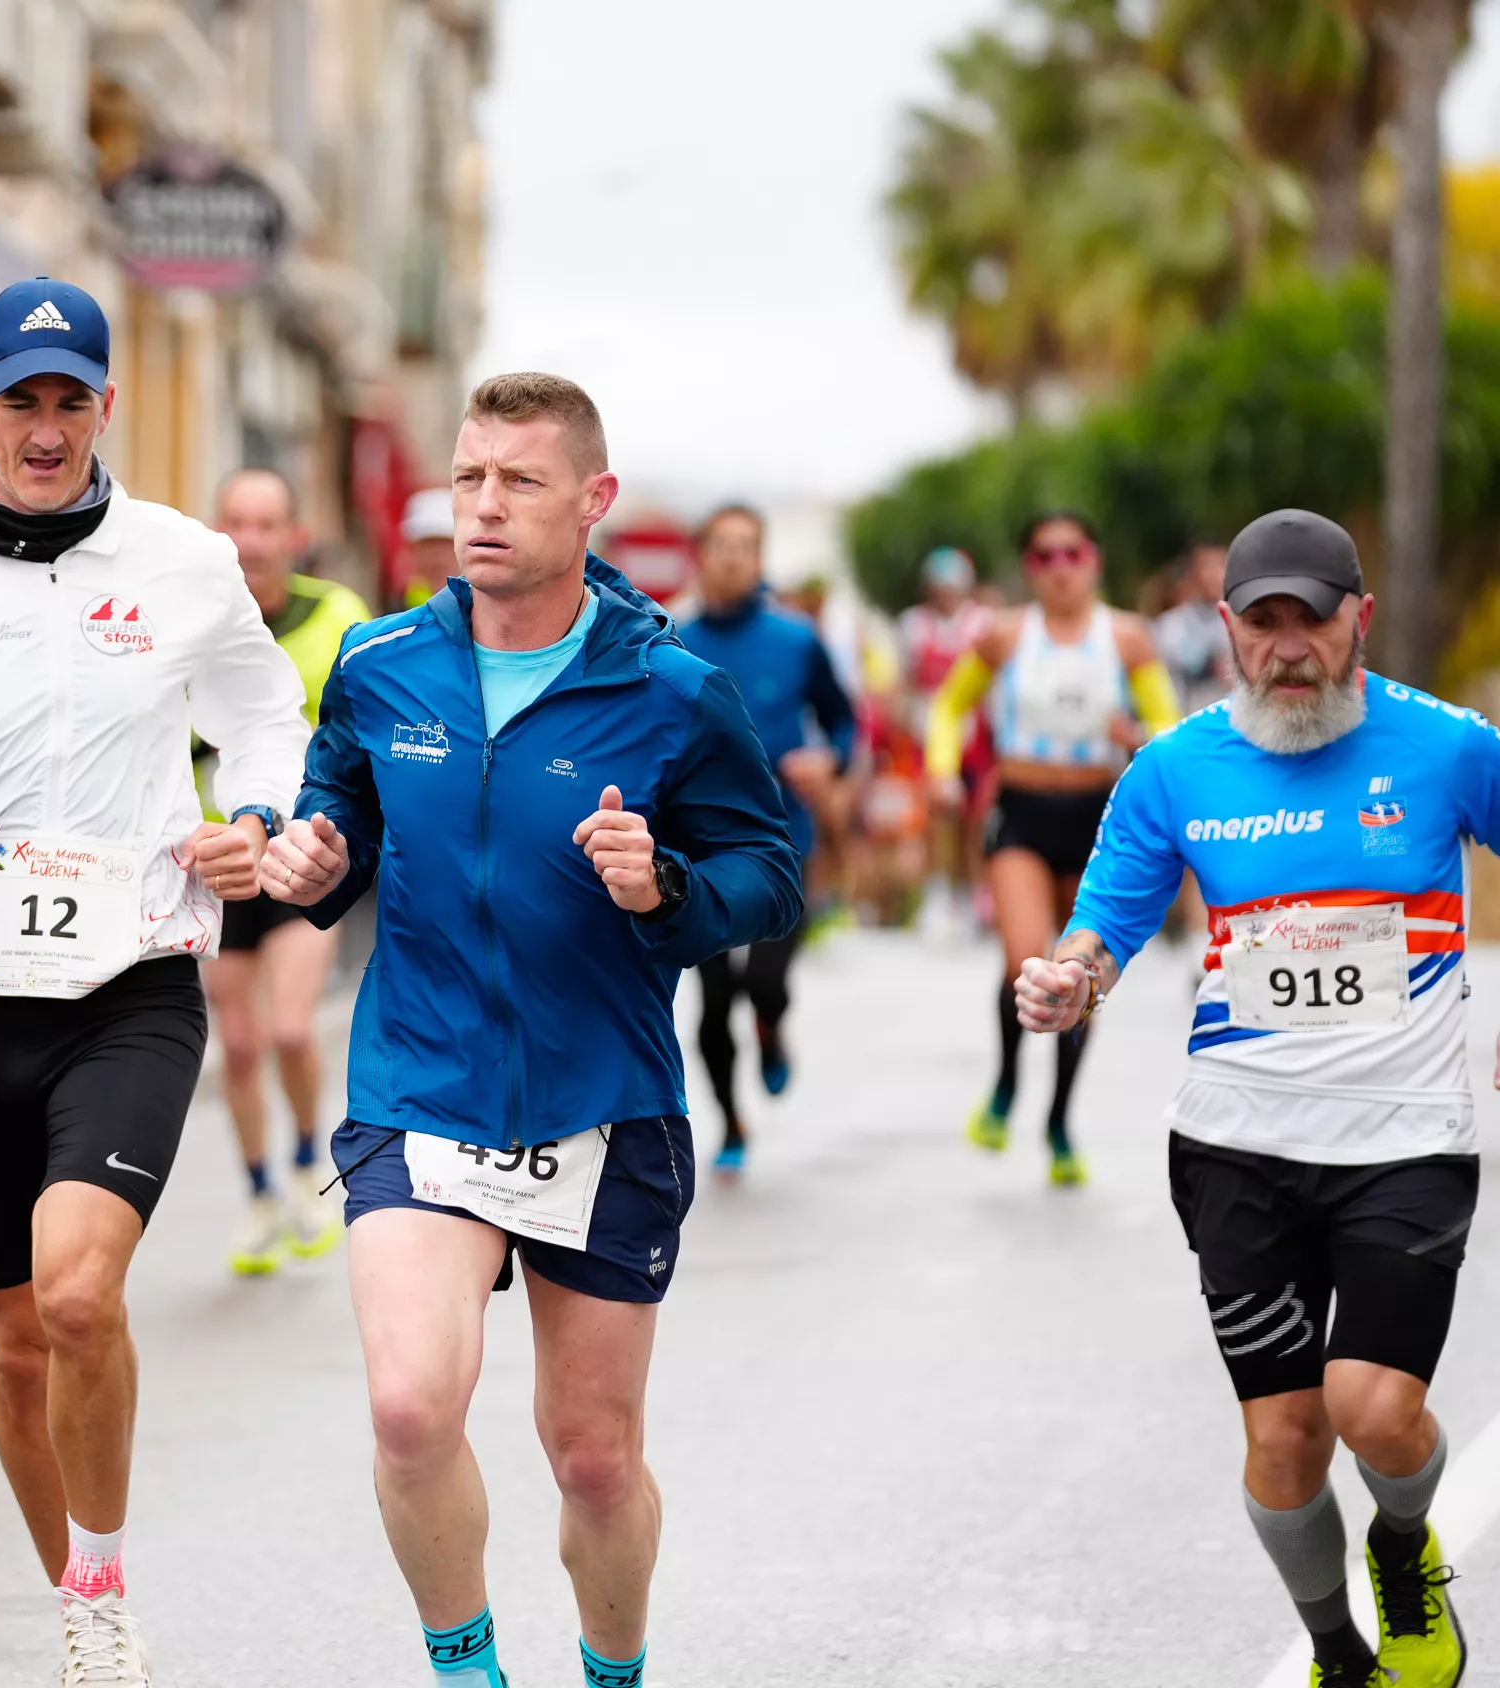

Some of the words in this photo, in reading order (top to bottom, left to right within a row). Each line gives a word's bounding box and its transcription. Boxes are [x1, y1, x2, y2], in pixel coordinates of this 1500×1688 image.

[20, 316, 71, 332] adidas
[86, 621, 148, 633] abades
[104, 632, 152, 644] stone
[545, 765, 578, 778] Kalenji
[1186, 809, 1324, 843] enerplus
[30, 860, 86, 881] LUCENA
[20, 894, 78, 939] 12
[1292, 936, 1347, 950] LUCENA
[1269, 964, 1364, 1007] 918
[457, 1141, 559, 1181] 496
[482, 1191, 515, 1205] M-Hombre
